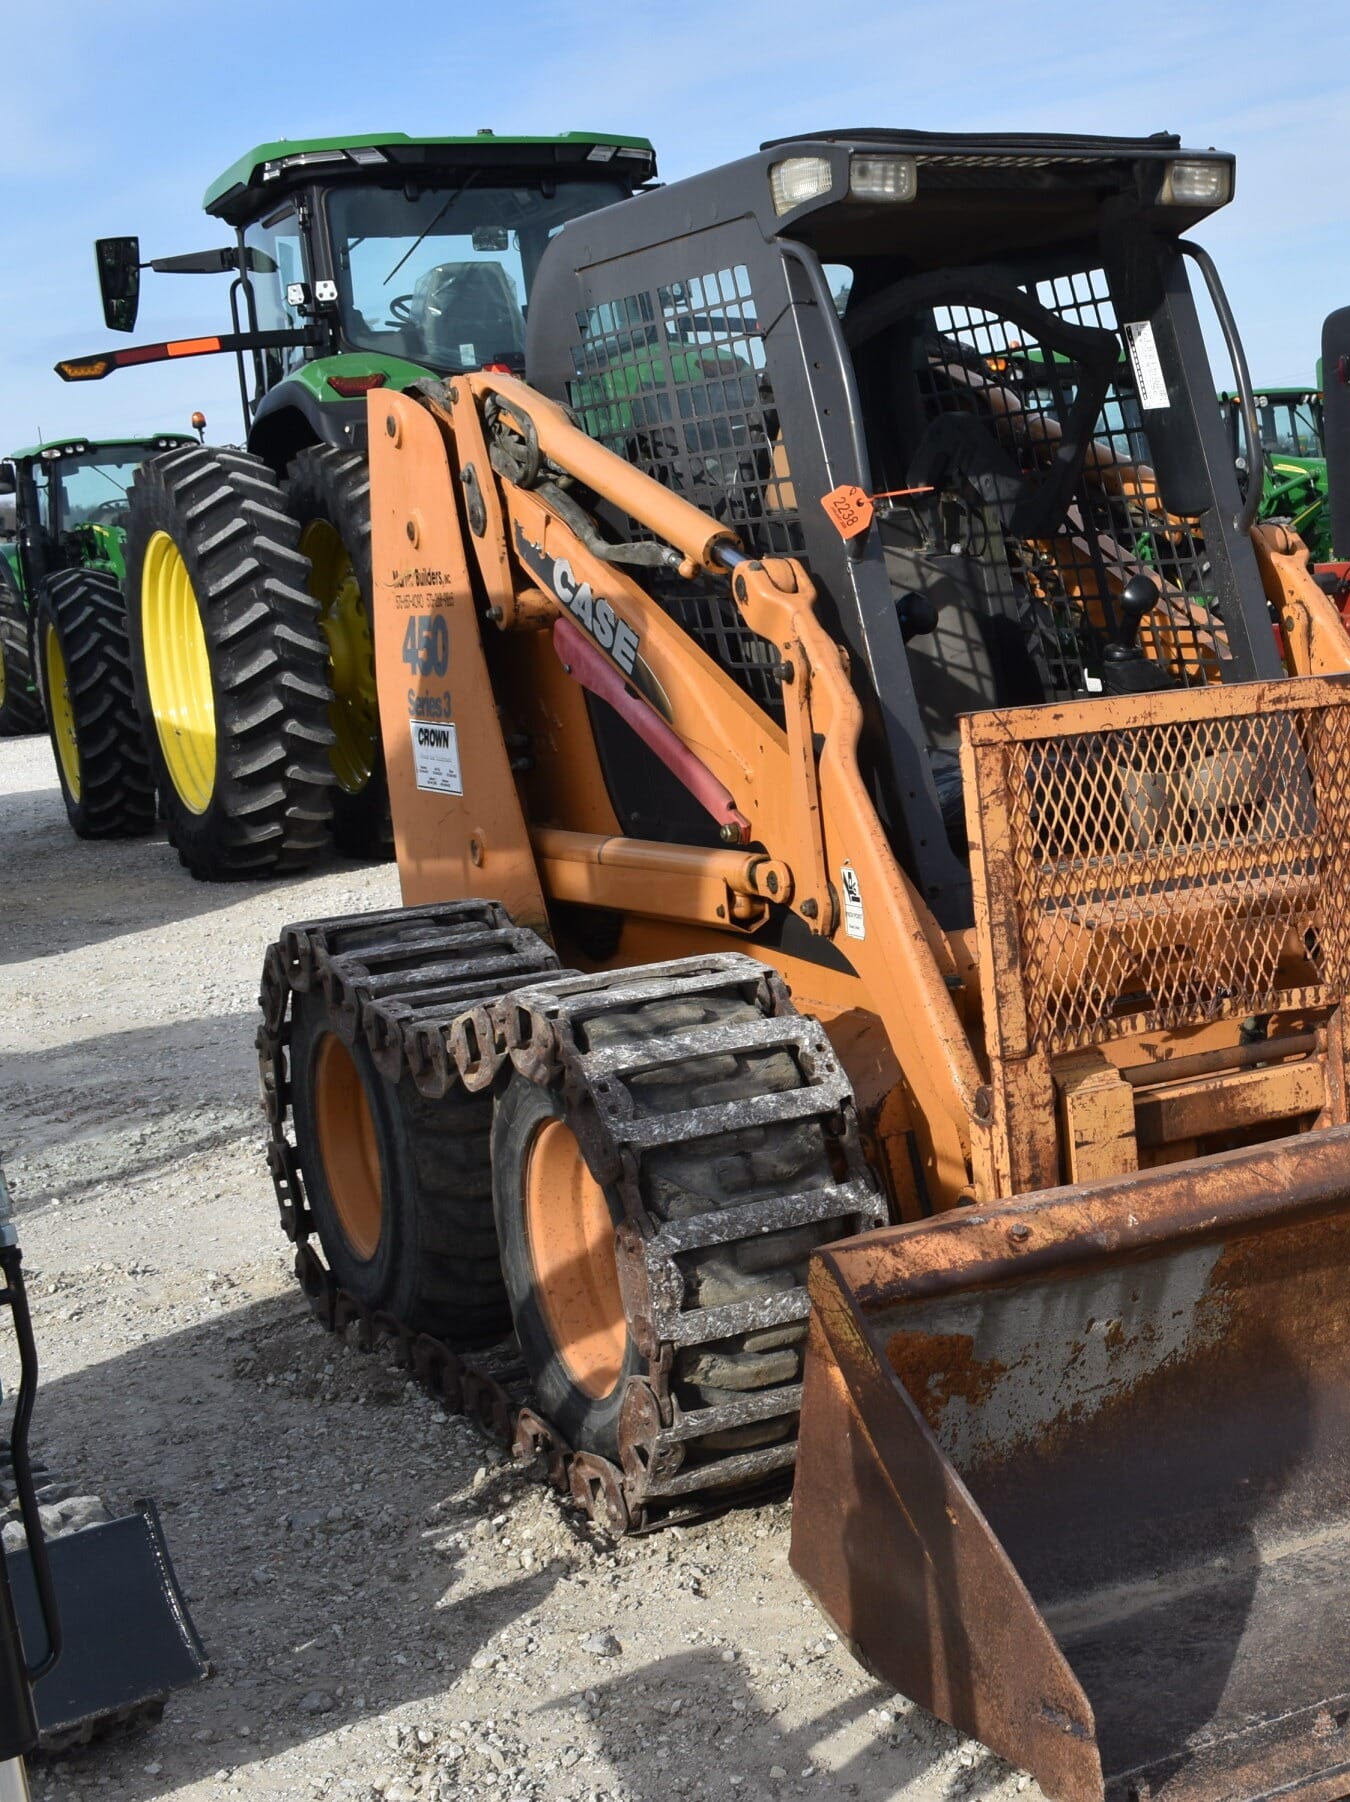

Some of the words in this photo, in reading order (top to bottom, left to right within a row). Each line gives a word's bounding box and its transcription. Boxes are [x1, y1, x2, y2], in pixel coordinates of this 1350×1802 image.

[832, 496, 859, 527] 2238
[552, 557, 640, 675] CASE
[402, 614, 449, 678] 450
[408, 688, 442, 719] Series
[443, 690, 453, 719] 3
[418, 727, 450, 749] CROWN
